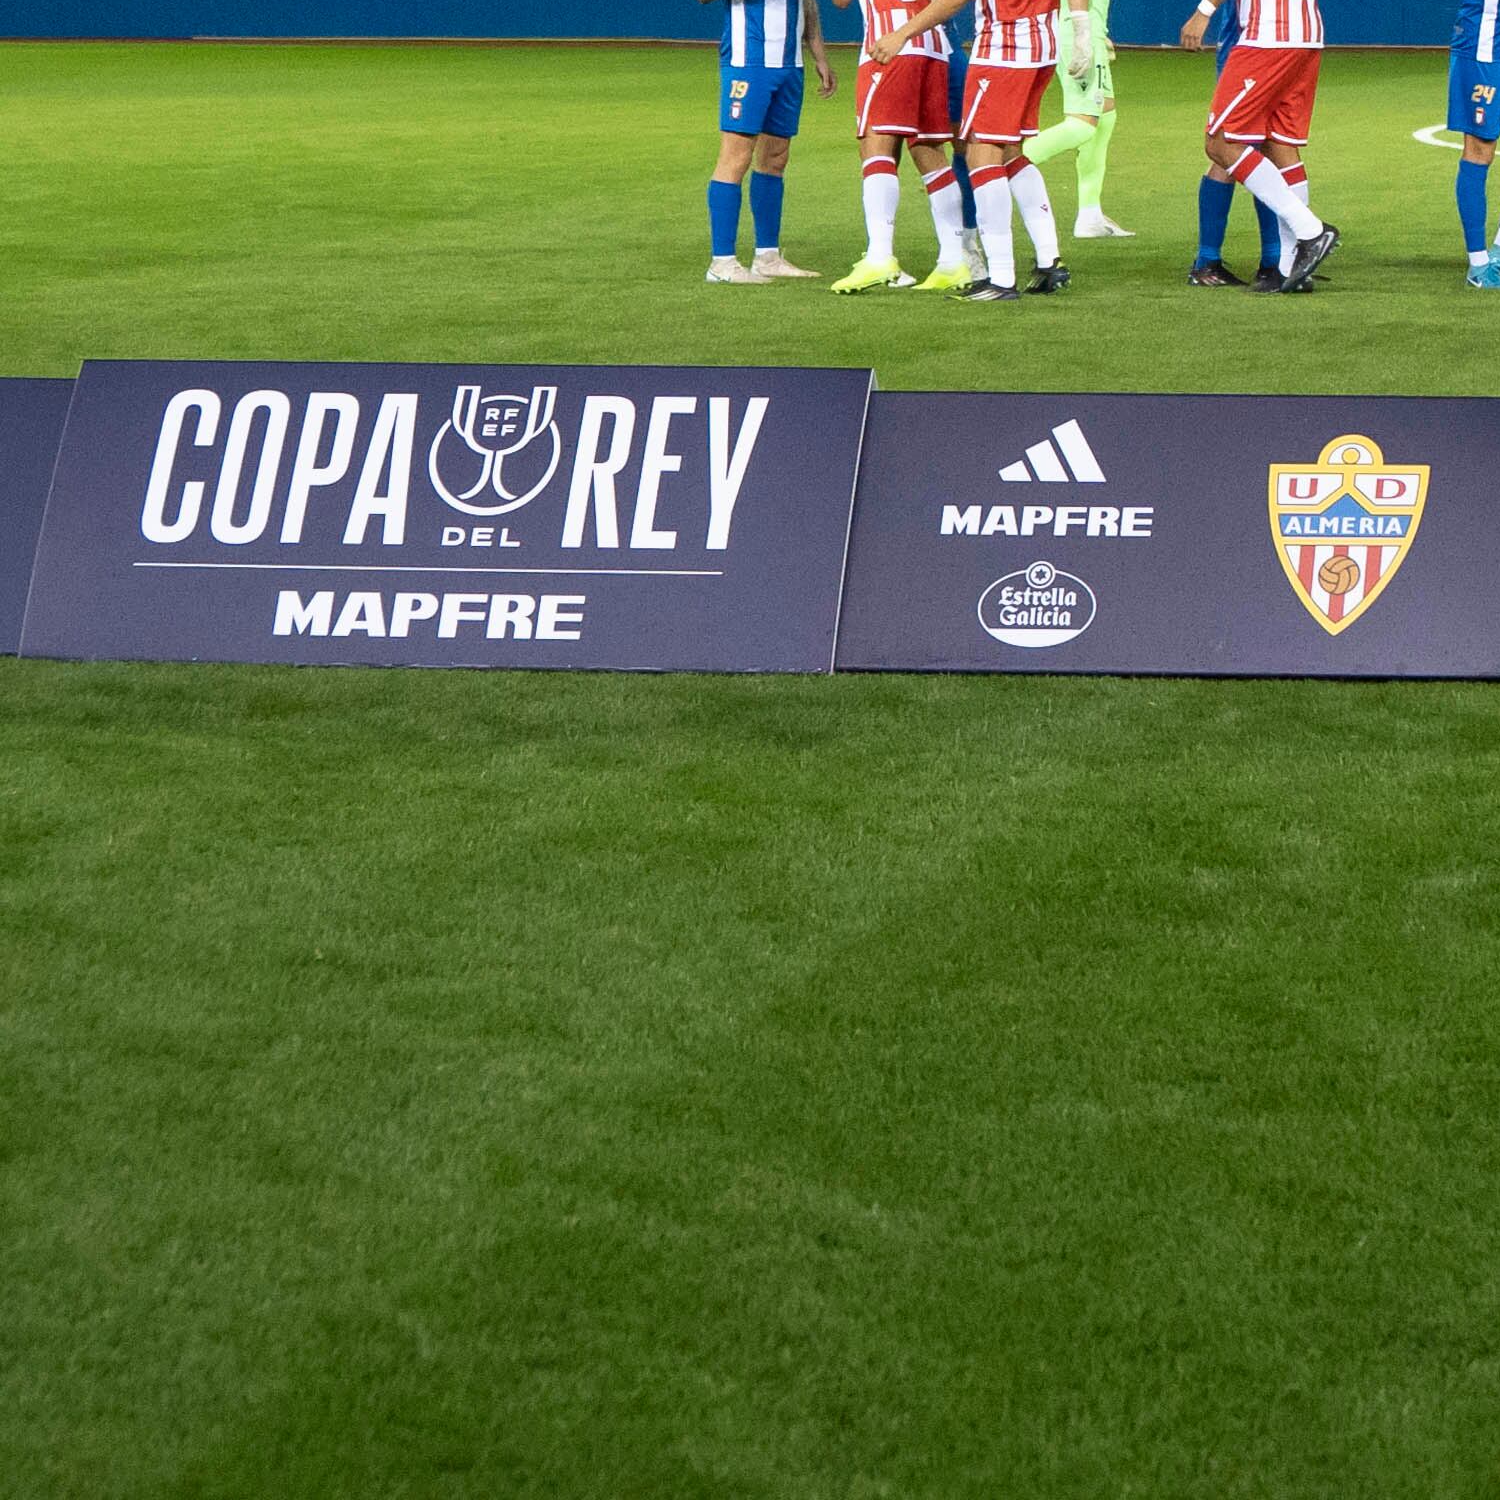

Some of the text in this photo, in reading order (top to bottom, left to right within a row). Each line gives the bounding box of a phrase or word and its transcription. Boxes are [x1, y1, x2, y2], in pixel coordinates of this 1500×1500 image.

[729, 79, 749, 99] 19
[1471, 84, 1496, 105] 24
[483, 406, 520, 421] RF
[481, 422, 518, 437] EF
[140, 388, 771, 551] COPA DEL REY
[1286, 477, 1407, 501] U D
[939, 504, 1154, 538] MAPFRE
[1282, 514, 1405, 537] ALMERIA
[997, 586, 1078, 610] Estrella
[271, 589, 588, 642] MAPFRE
[997, 606, 1072, 628] Galicia
